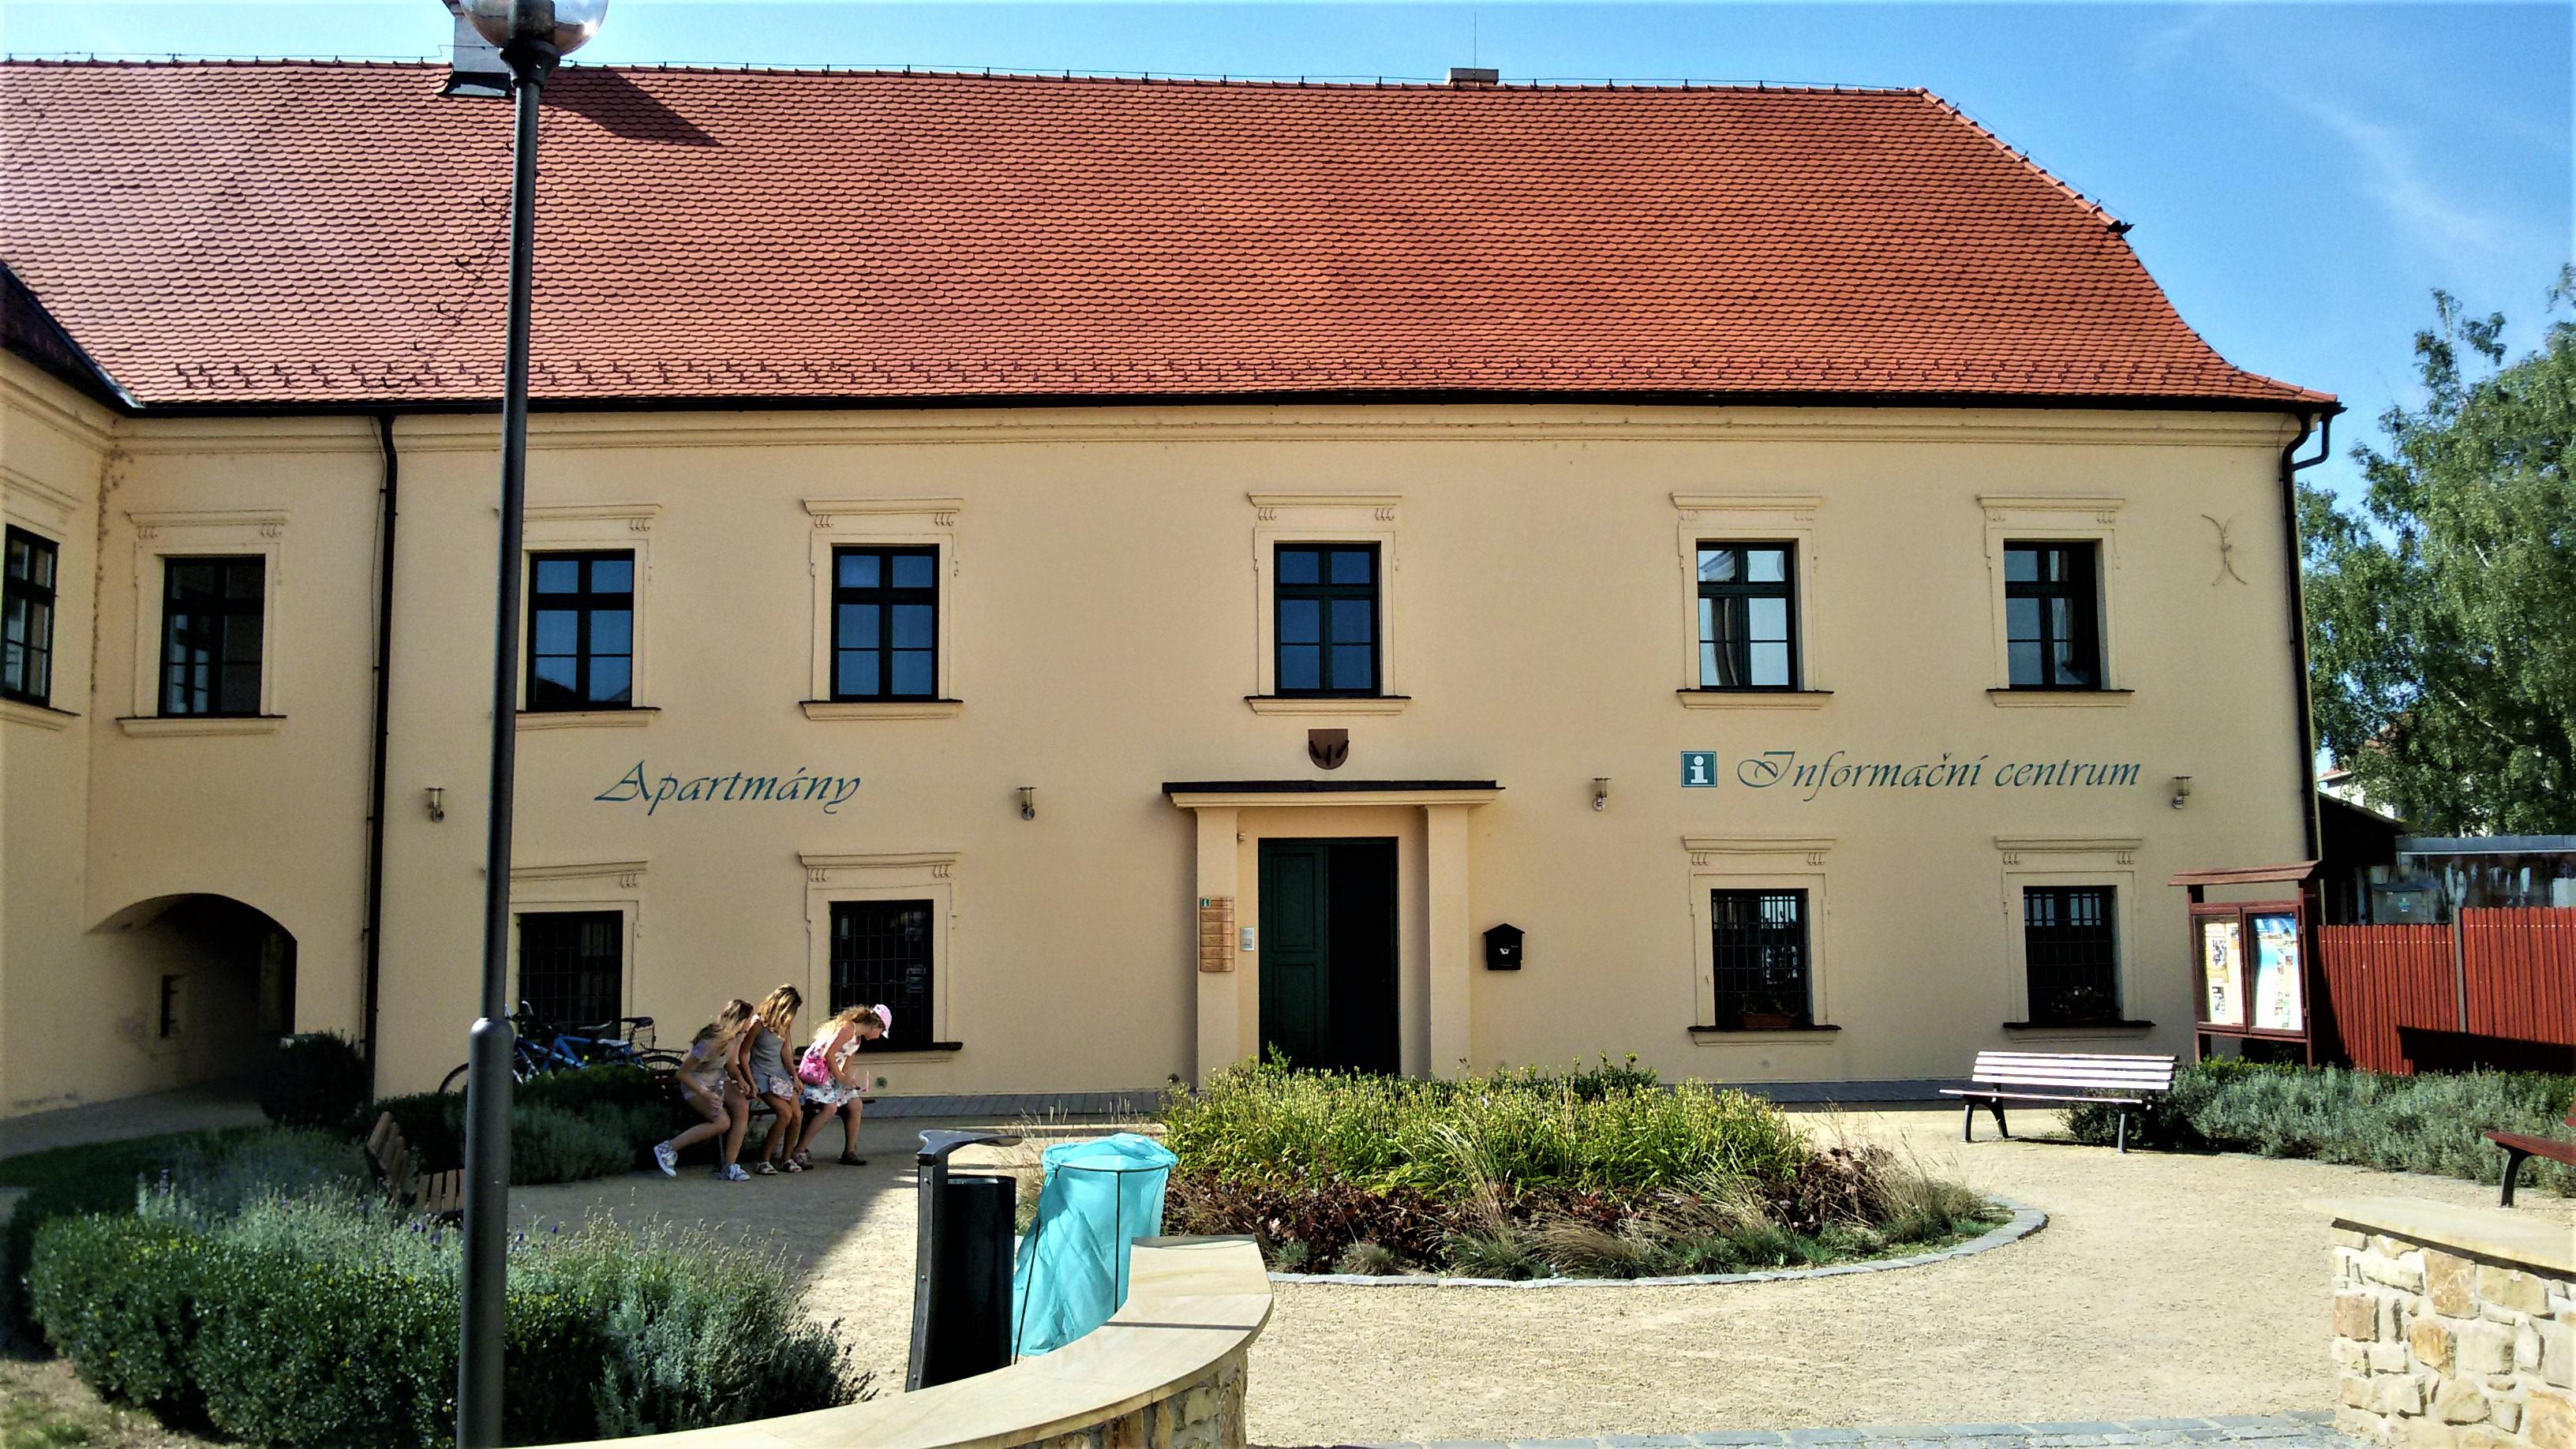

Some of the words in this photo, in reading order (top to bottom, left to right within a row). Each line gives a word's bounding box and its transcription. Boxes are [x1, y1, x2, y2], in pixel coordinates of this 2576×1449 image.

[593, 759, 861, 817] Apartmány
[1737, 750, 1989, 803] Informační
[1994, 758, 2141, 788] centrum
